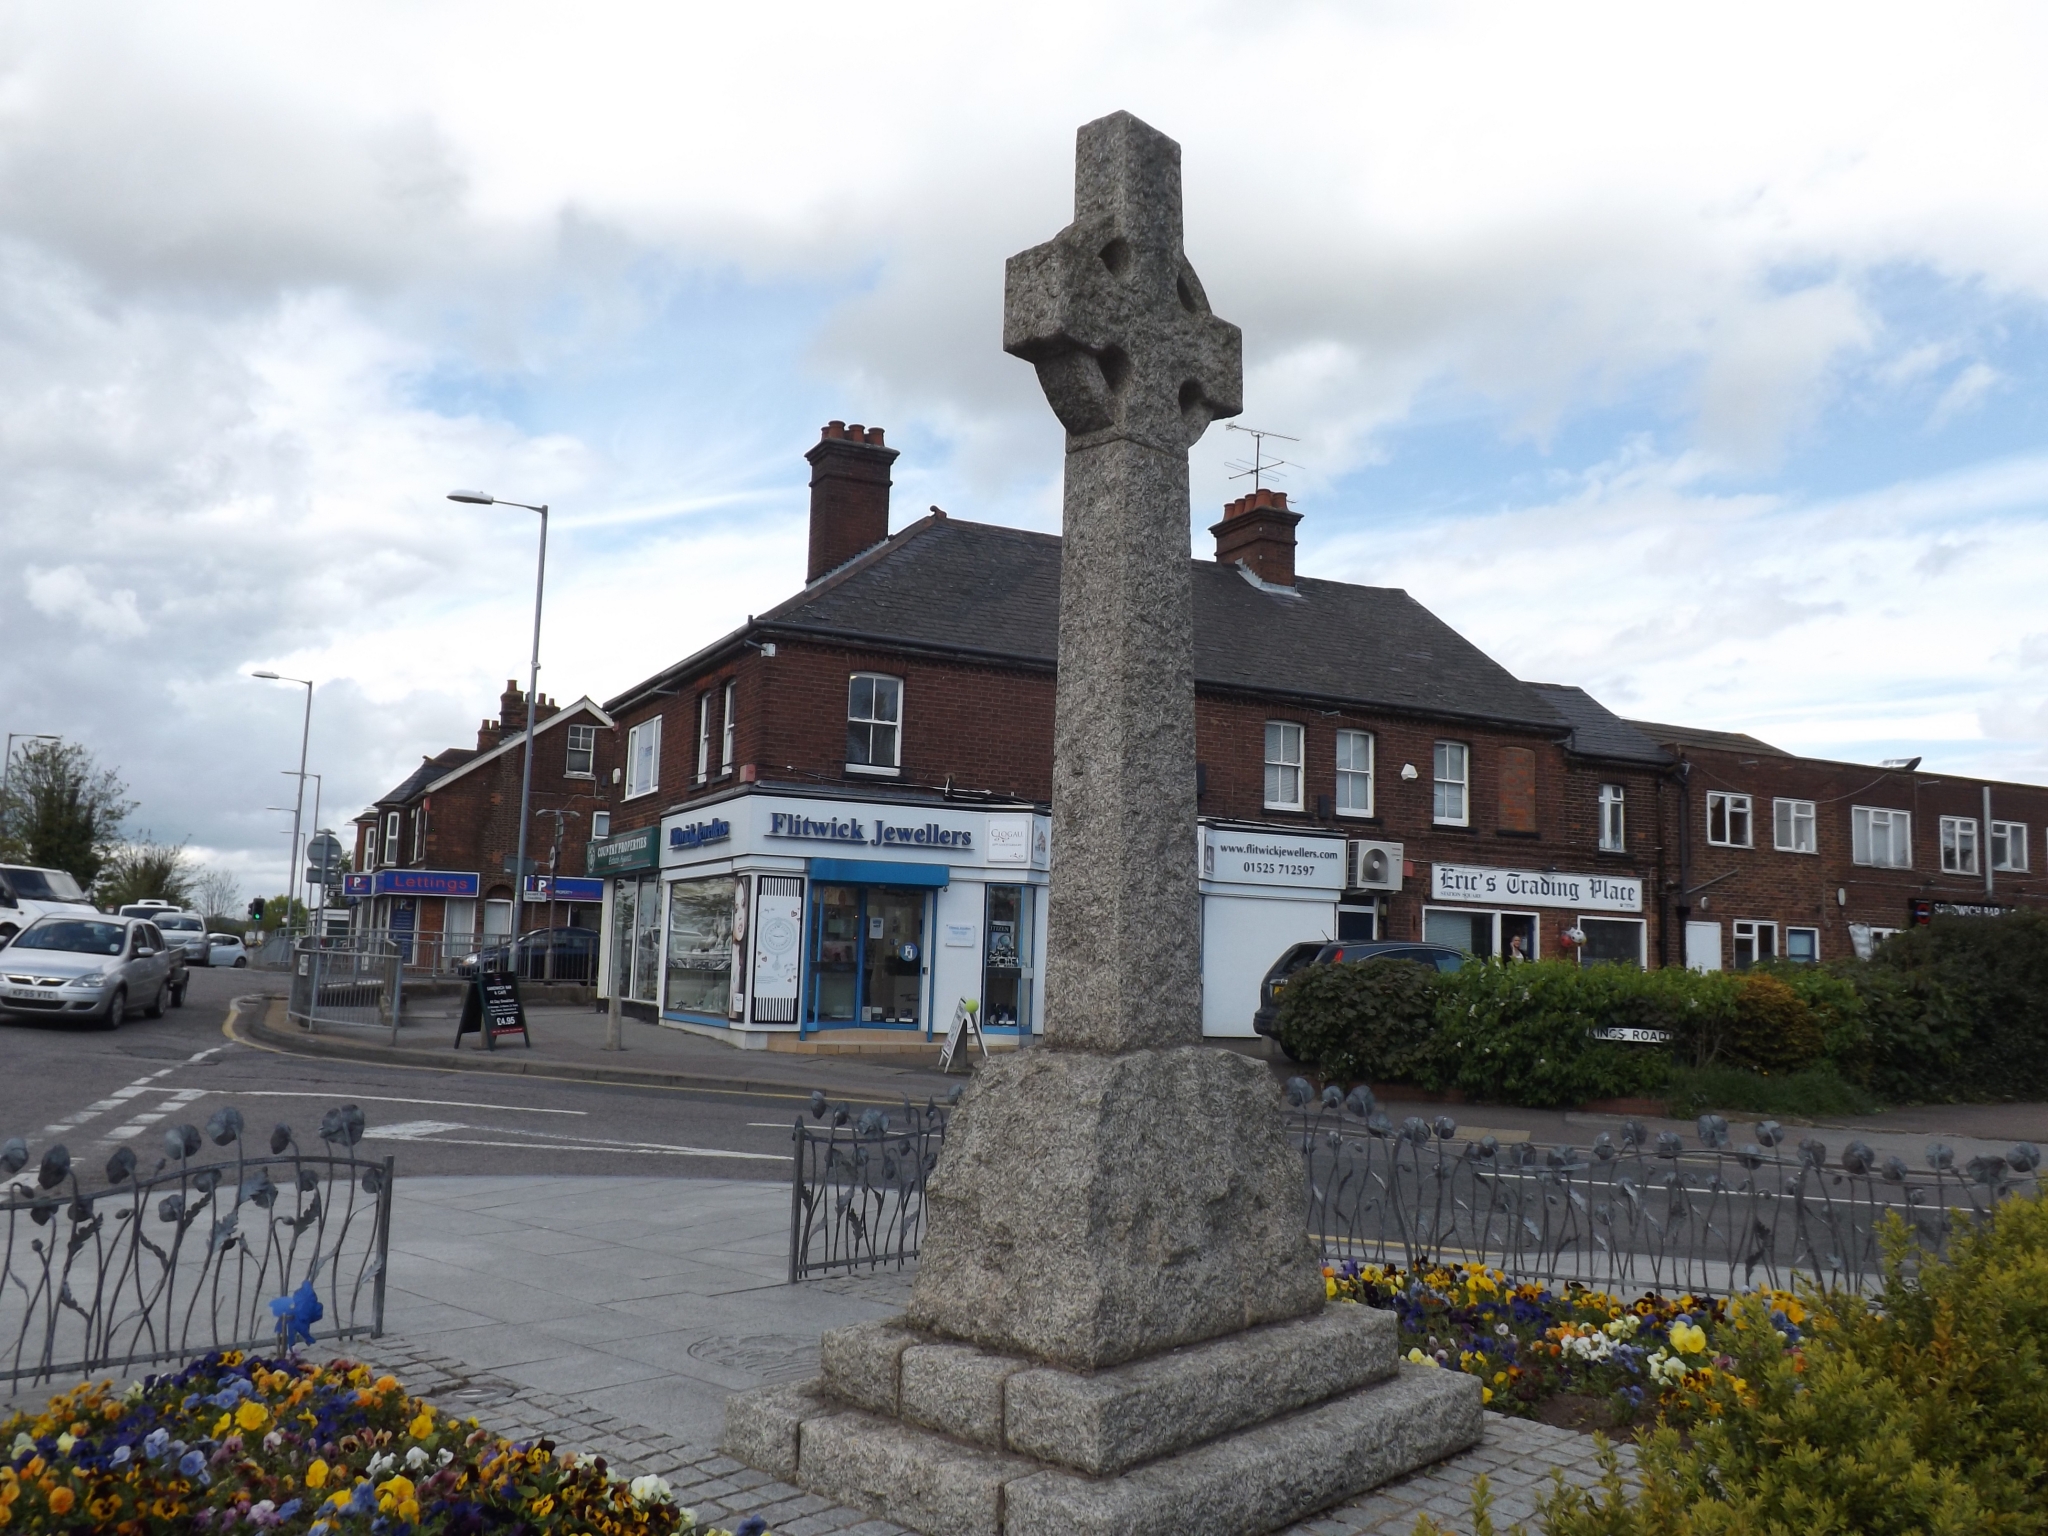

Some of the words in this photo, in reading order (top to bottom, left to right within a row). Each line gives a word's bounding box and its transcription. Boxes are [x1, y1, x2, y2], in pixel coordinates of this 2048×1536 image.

[770, 812, 865, 839] Flitwick
[870, 819, 972, 846] Jewellers
[597, 843, 618, 858] COUNTRY
[618, 836, 647, 854] PROPERTIES
[1220, 843, 1338, 860] www.flitwickjewellers.com
[1243, 861, 1275, 874] 01525
[1278, 863, 1315, 876] 712597
[395, 875, 468, 892] Lettings
[1440, 868, 1497, 892] Eric's
[1506, 873, 1580, 901] Trading
[1589, 878, 1635, 901] Place
[496, 1016, 516, 1026] £4.95
[1588, 1027, 1625, 1040] KINGS
[1632, 1030, 1667, 1041] ROAD
